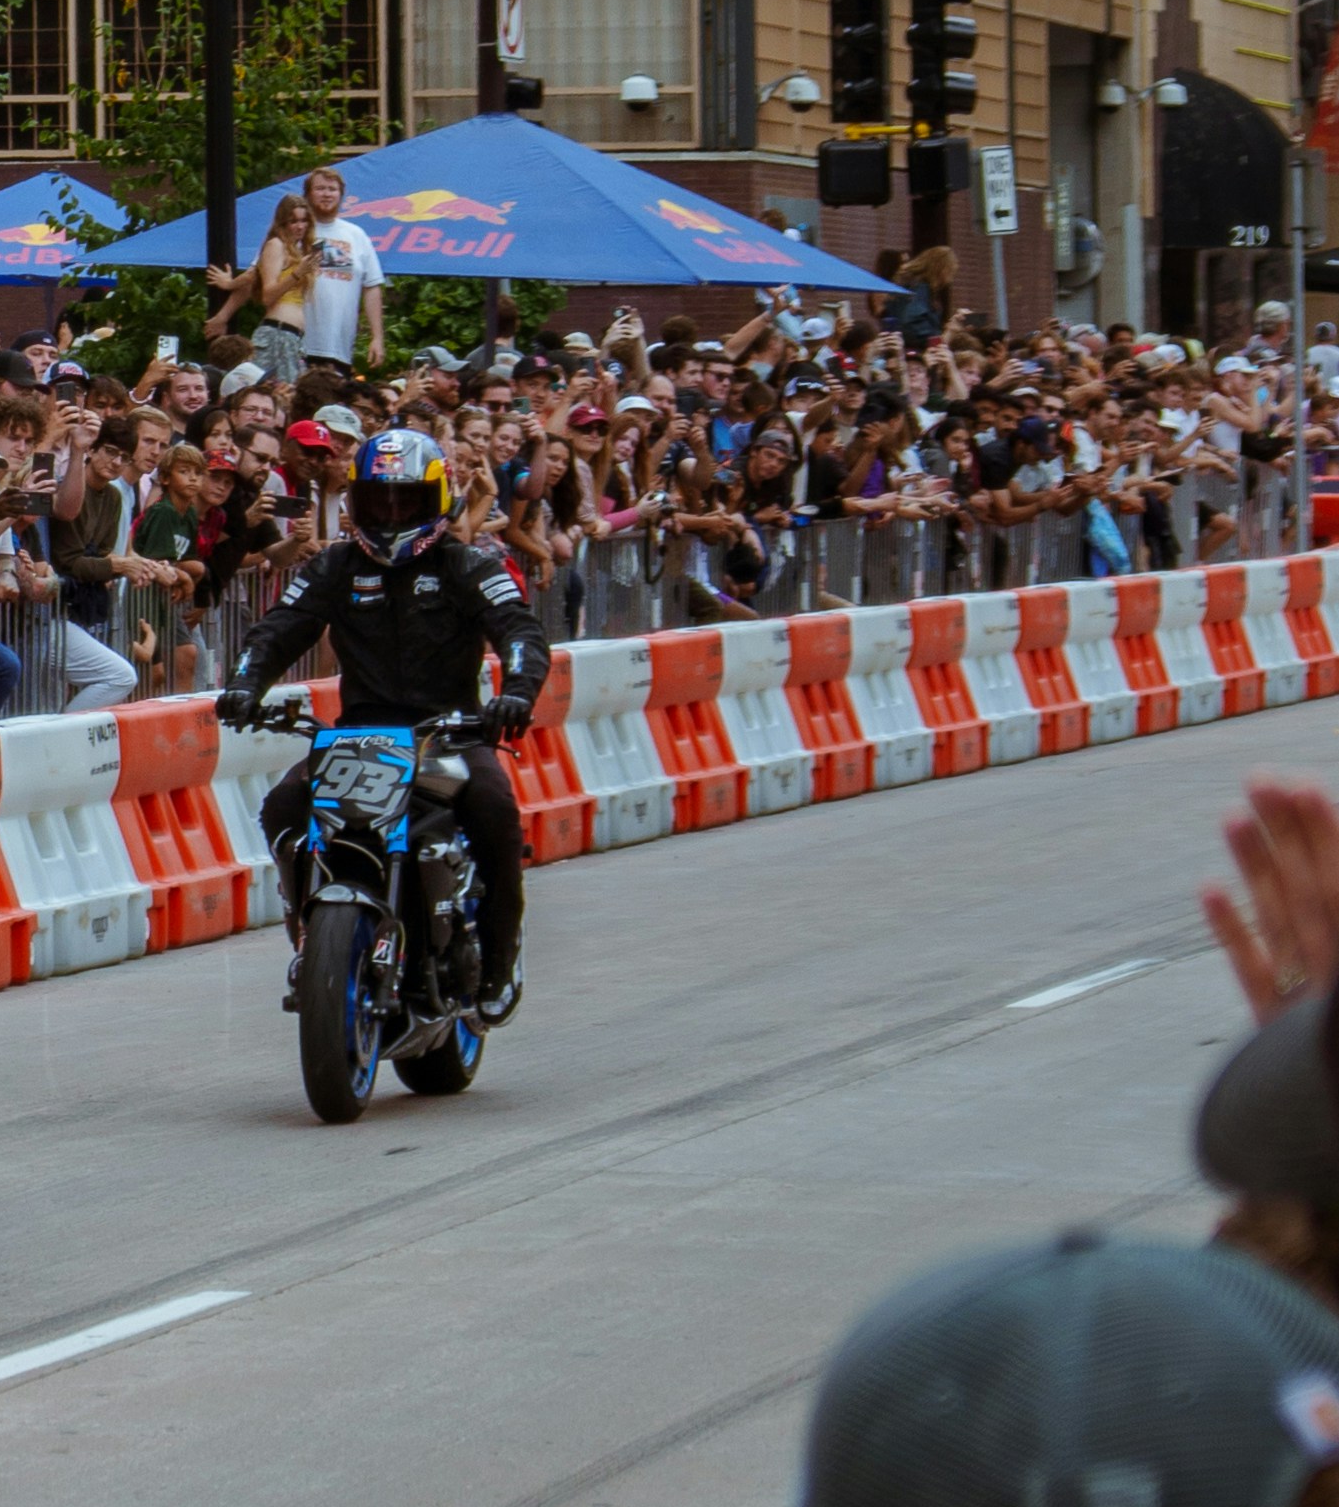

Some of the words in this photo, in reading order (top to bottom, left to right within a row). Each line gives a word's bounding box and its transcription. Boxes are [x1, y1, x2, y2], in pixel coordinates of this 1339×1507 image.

[398, 226, 515, 258] Bull
[1229, 225, 1270, 247] 219
[315, 758, 401, 804] 93
